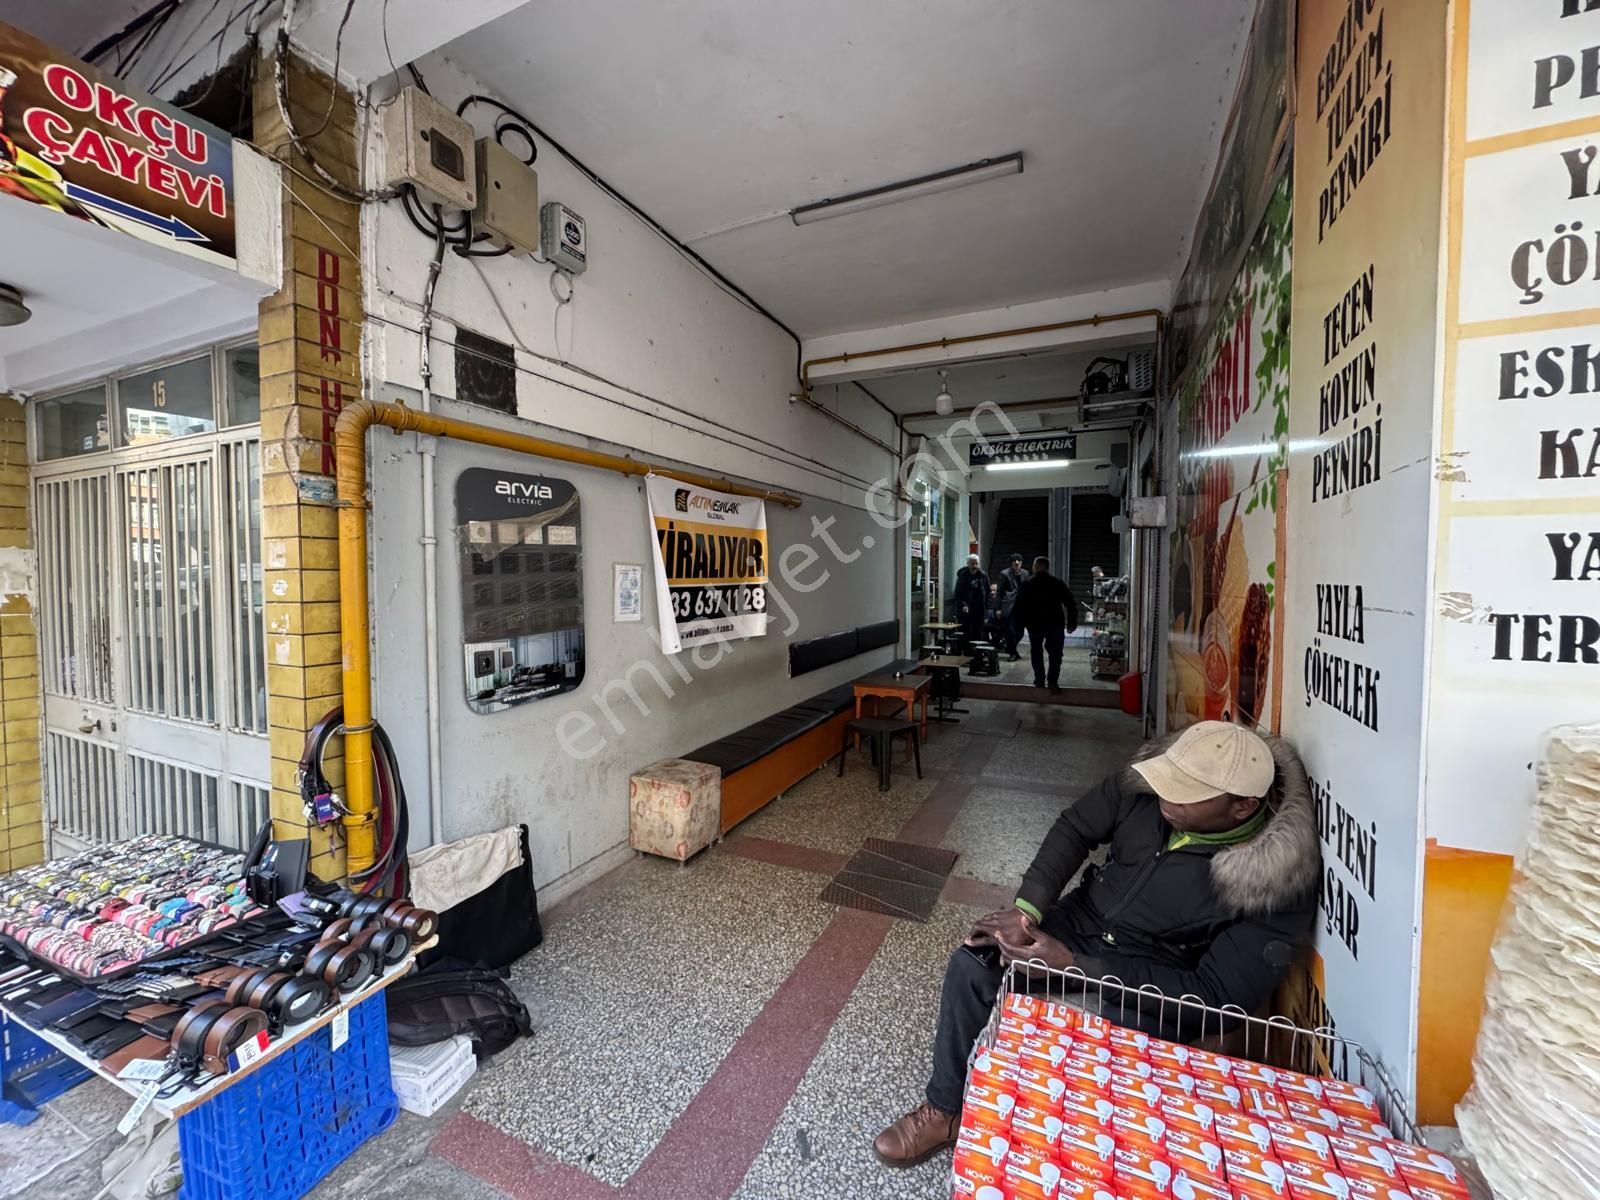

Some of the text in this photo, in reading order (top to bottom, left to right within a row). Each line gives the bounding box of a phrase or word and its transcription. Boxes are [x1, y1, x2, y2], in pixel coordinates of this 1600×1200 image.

[1316, 0, 1376, 123] ERZİN
[1327, 8, 1384, 166] TULUM
[43, 64, 208, 165] OKÇU
[1318, 59, 1393, 245] PEYNİRİ
[23, 107, 227, 218] ÇAYEVİ
[1560, 145, 1600, 199] Y
[1511, 221, 1600, 305] ÇÖ
[1323, 263, 1374, 367] TECEN
[152, 380, 166, 407] 15
[1319, 342, 1377, 435] KOYUN
[1498, 344, 1600, 400] ESK
[495, 480, 552, 499] arvia
[1312, 403, 1383, 503] PEYNİRİ
[507, 496, 542, 506] ELECTRIC
[694, 589, 723, 616] 637
[742, 587, 766, 611] 28
[1316, 583, 1365, 645] YAYLA
[1488, 613, 1600, 664] TER
[1304, 637, 1381, 733] ÇÖKELEK
